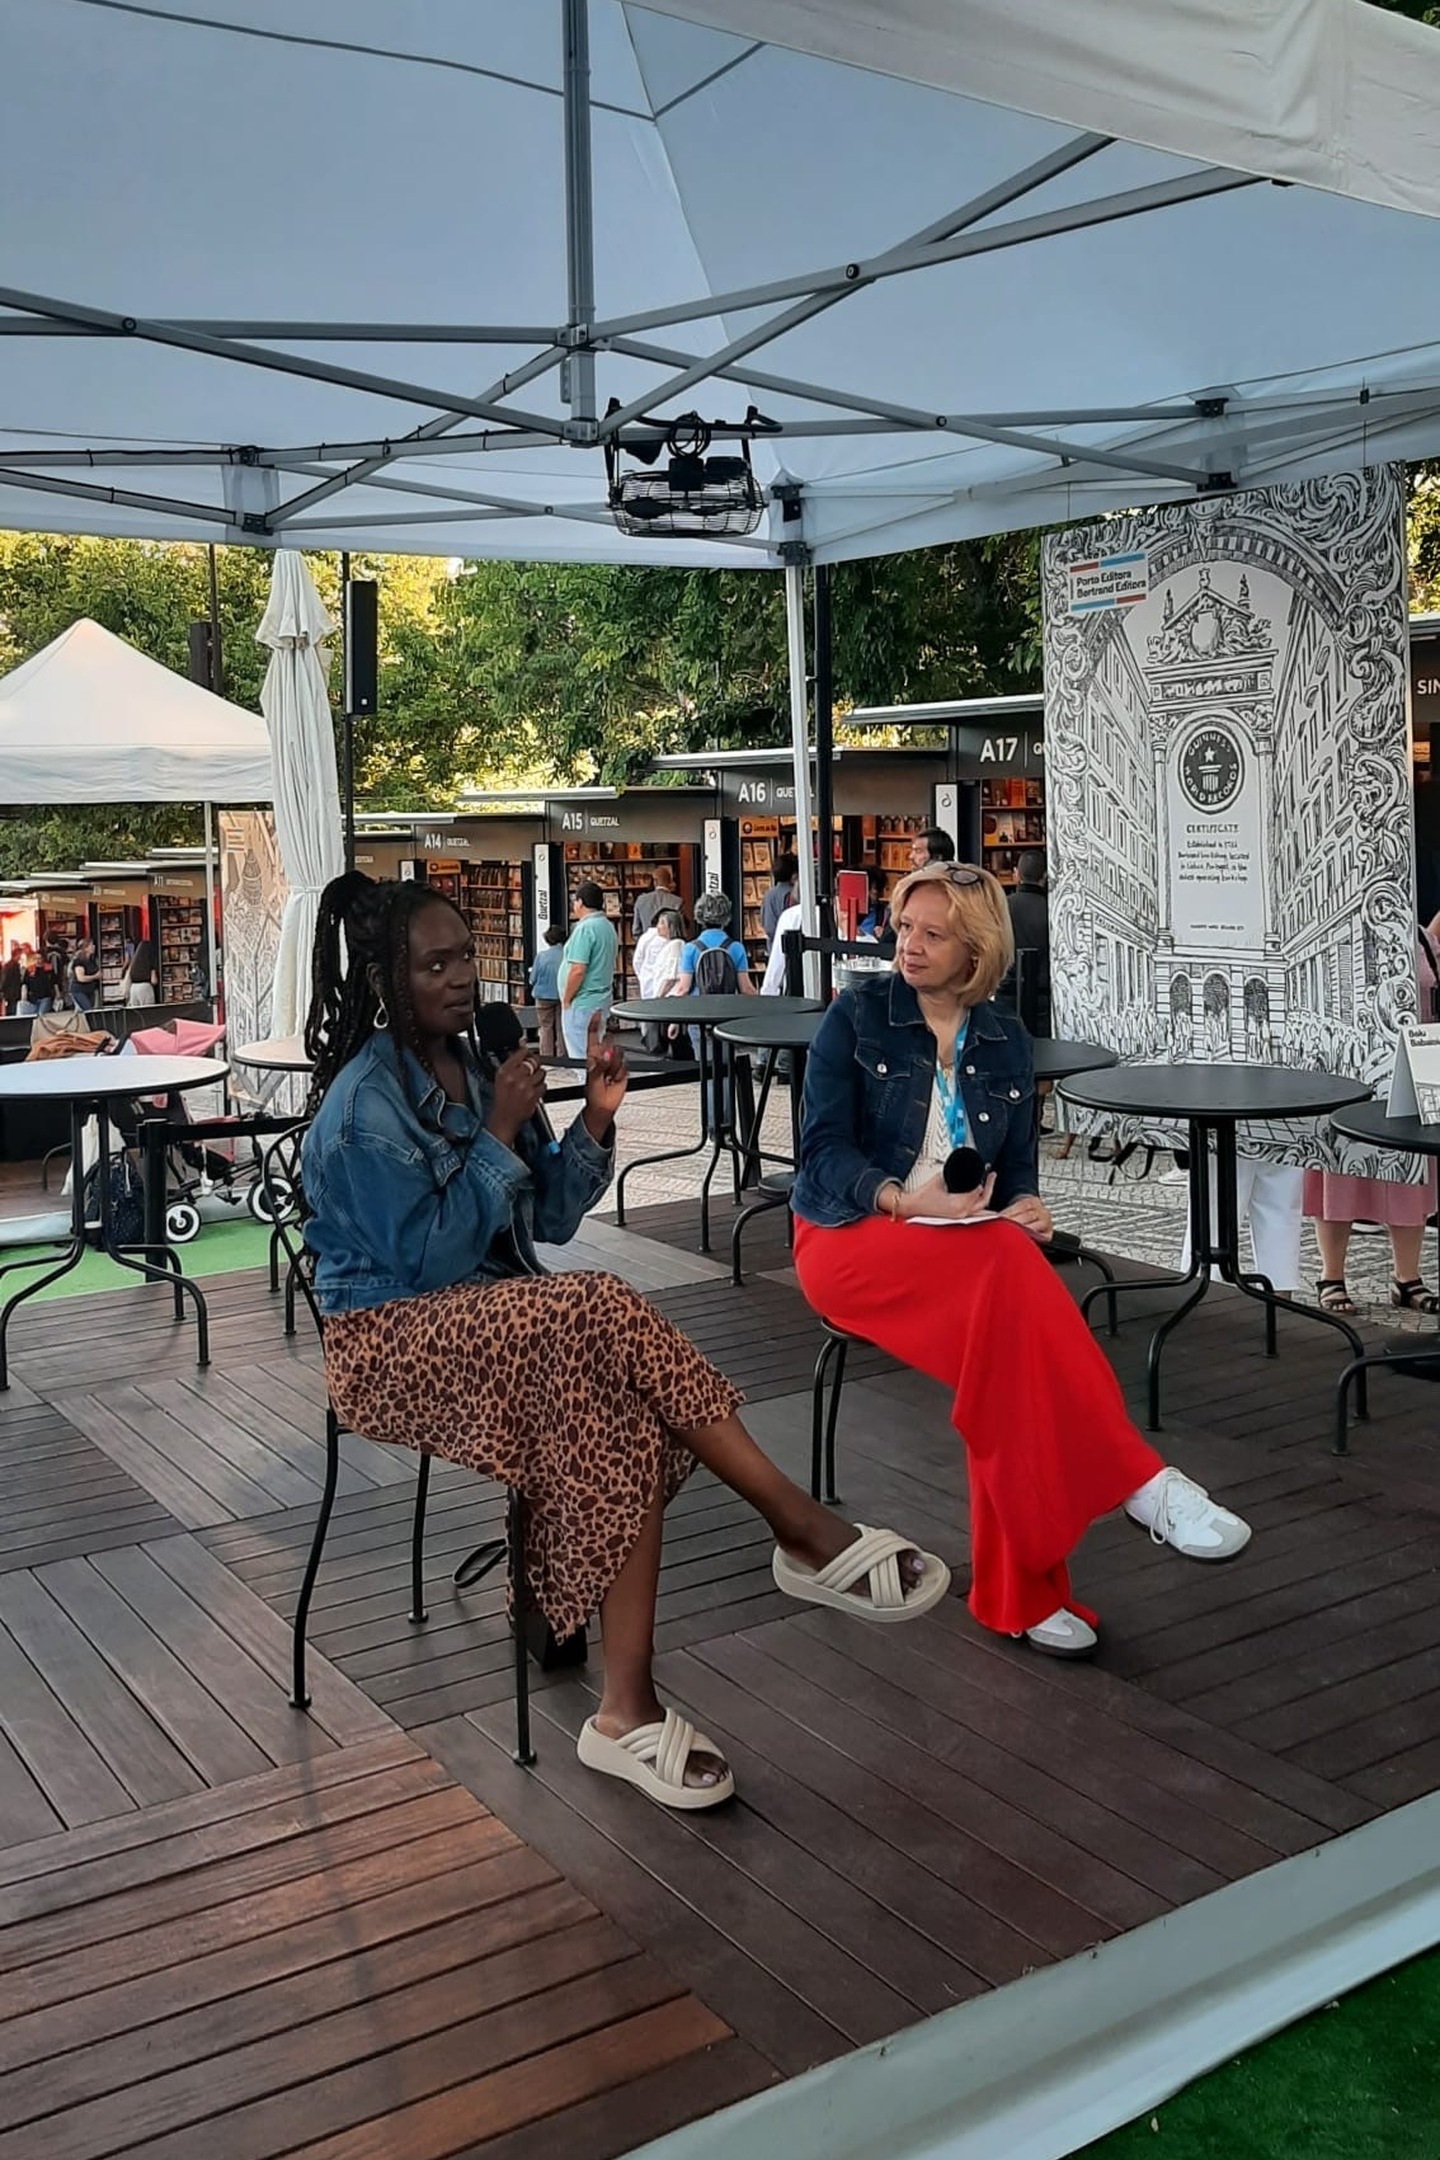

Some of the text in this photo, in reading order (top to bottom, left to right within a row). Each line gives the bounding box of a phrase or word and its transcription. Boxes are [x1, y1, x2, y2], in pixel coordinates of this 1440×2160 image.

[1101, 570, 1132, 583] Editora
[980, 737, 1018, 763] A17
[738, 782, 766, 803] A16
[562, 812, 583, 830] A15
[424, 833, 442, 849] A14
